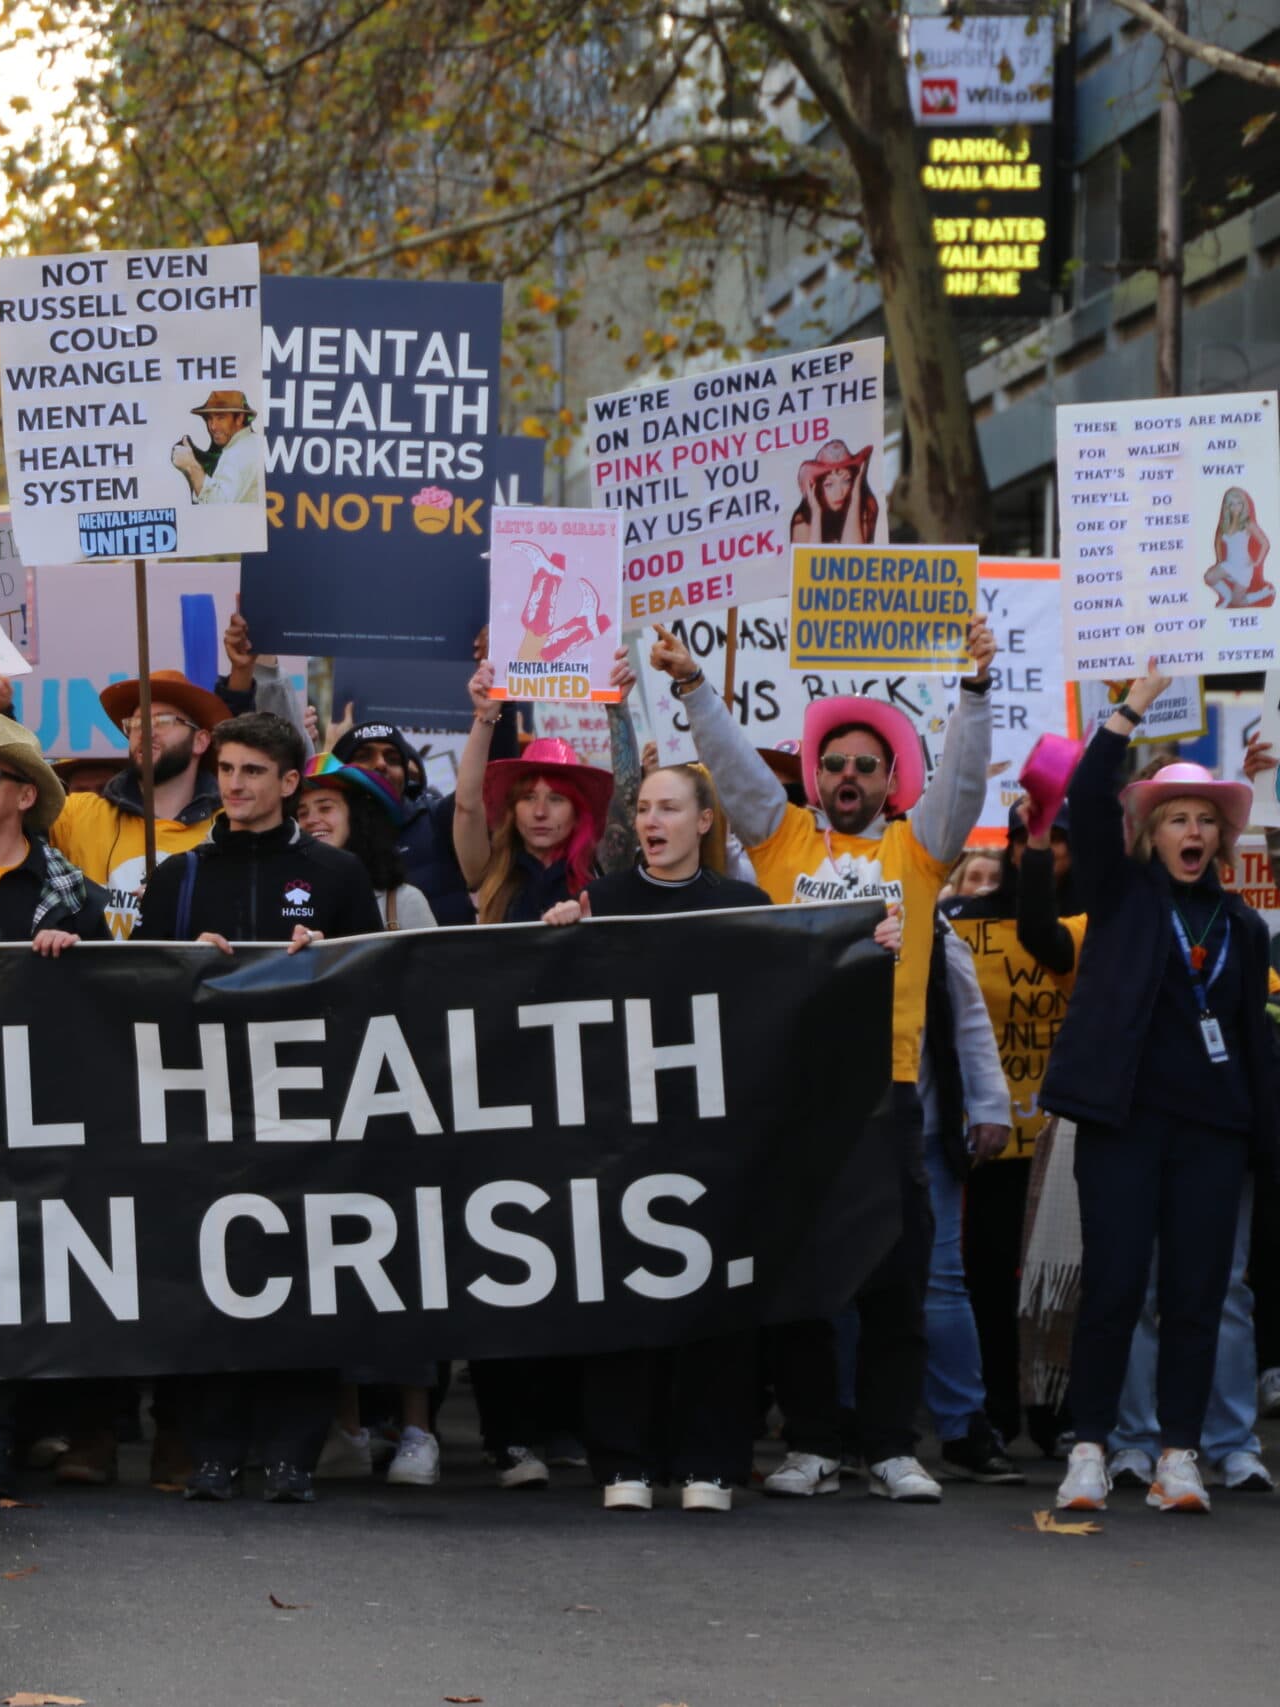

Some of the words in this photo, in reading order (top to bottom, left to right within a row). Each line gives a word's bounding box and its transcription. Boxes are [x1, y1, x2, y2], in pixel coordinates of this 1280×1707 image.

[931, 138, 1029, 162] PARKI
[923, 165, 1041, 188] AVAILABLE
[933, 218, 971, 242] EST
[974, 218, 1046, 242] RATES
[41, 260, 108, 287] NOT
[127, 254, 208, 280] EVEN
[940, 245, 1040, 269] AILABLE
[136, 285, 257, 312] COIGHT
[49, 324, 157, 354] COULD
[262, 325, 488, 379] MENTAL
[6, 358, 161, 391] WRANGLE
[176, 356, 237, 381] THE
[594, 389, 670, 422] WE'RE
[694, 368, 777, 402] GONNA
[792, 351, 853, 383] KEEP
[17, 402, 147, 432] MENTAL
[262, 379, 488, 435] HEALTH
[596, 427, 629, 454] ON
[643, 398, 770, 445] DANCING
[778, 386, 814, 416] AT
[822, 376, 877, 407] THE
[1074, 422, 1118, 433] THESE
[1135, 417, 1182, 431] BOOTS
[1188, 414, 1217, 426] ARE
[1220, 412, 1262, 424] MADE
[19, 443, 133, 472] HEALTH
[265, 435, 483, 480] WORKERS
[596, 450, 663, 487] PINK
[673, 432, 747, 473] PONY
[756, 417, 829, 452] CLUB
[1079, 448, 1106, 459] FOR
[1127, 442, 1180, 457] WALKIN
[1207, 439, 1237, 451] AND
[605, 476, 689, 510] UNTIL
[704, 459, 759, 491] YOU
[1075, 468, 1125, 481] THAT'S
[1139, 470, 1174, 481] JUST
[1202, 464, 1245, 476] WHAT
[24, 477, 138, 506] SYSTEM
[1072, 492, 1129, 504] THEY'LL
[1152, 495, 1172, 506] DO
[79, 512, 127, 529] MENTAL
[128, 508, 175, 524] HEALTH
[296, 492, 403, 532] NOT
[624, 517, 659, 547] AY
[668, 508, 702, 536] US
[709, 488, 780, 523] FAIR,
[1076, 520, 1105, 532] ONE
[1108, 520, 1127, 531] OF
[1145, 514, 1190, 527] THESE
[79, 524, 177, 556] UNITED
[496, 521, 534, 534] LET'S
[539, 522, 557, 535] GO
[562, 521, 607, 536] GIRLS
[702, 529, 783, 566] LUCK,
[1079, 545, 1114, 558] DAYS
[1139, 539, 1184, 552] THESE
[810, 557, 963, 587] UNDERPAID,
[1076, 571, 1123, 584] BOOTS
[1150, 565, 1177, 576] ARE
[630, 573, 733, 618] EBABE!
[798, 587, 973, 616] UNDERVALUED,
[1073, 598, 1124, 611] GONNA
[1148, 592, 1189, 605] WALK
[1077, 627, 1120, 641] RIGHT
[1125, 624, 1145, 636] ON
[1154, 620, 1185, 633] OUT
[1188, 618, 1207, 630] OF
[1230, 616, 1259, 628] THE
[509, 662, 549, 675] MENTAL
[551, 661, 589, 674] HEALTH
[1077, 656, 1135, 670] MENTAL
[1218, 648, 1274, 661] SYSTEM
[508, 676, 590, 698] UNITED
[354, 725, 393, 738] HACSU
[1241, 853, 1274, 884] TH
[797, 878, 848, 900] MENTA
[282, 907, 314, 917] HACSU
[134, 993, 726, 1144] HEALTH
[199, 1173, 755, 1320] CRISIS.
